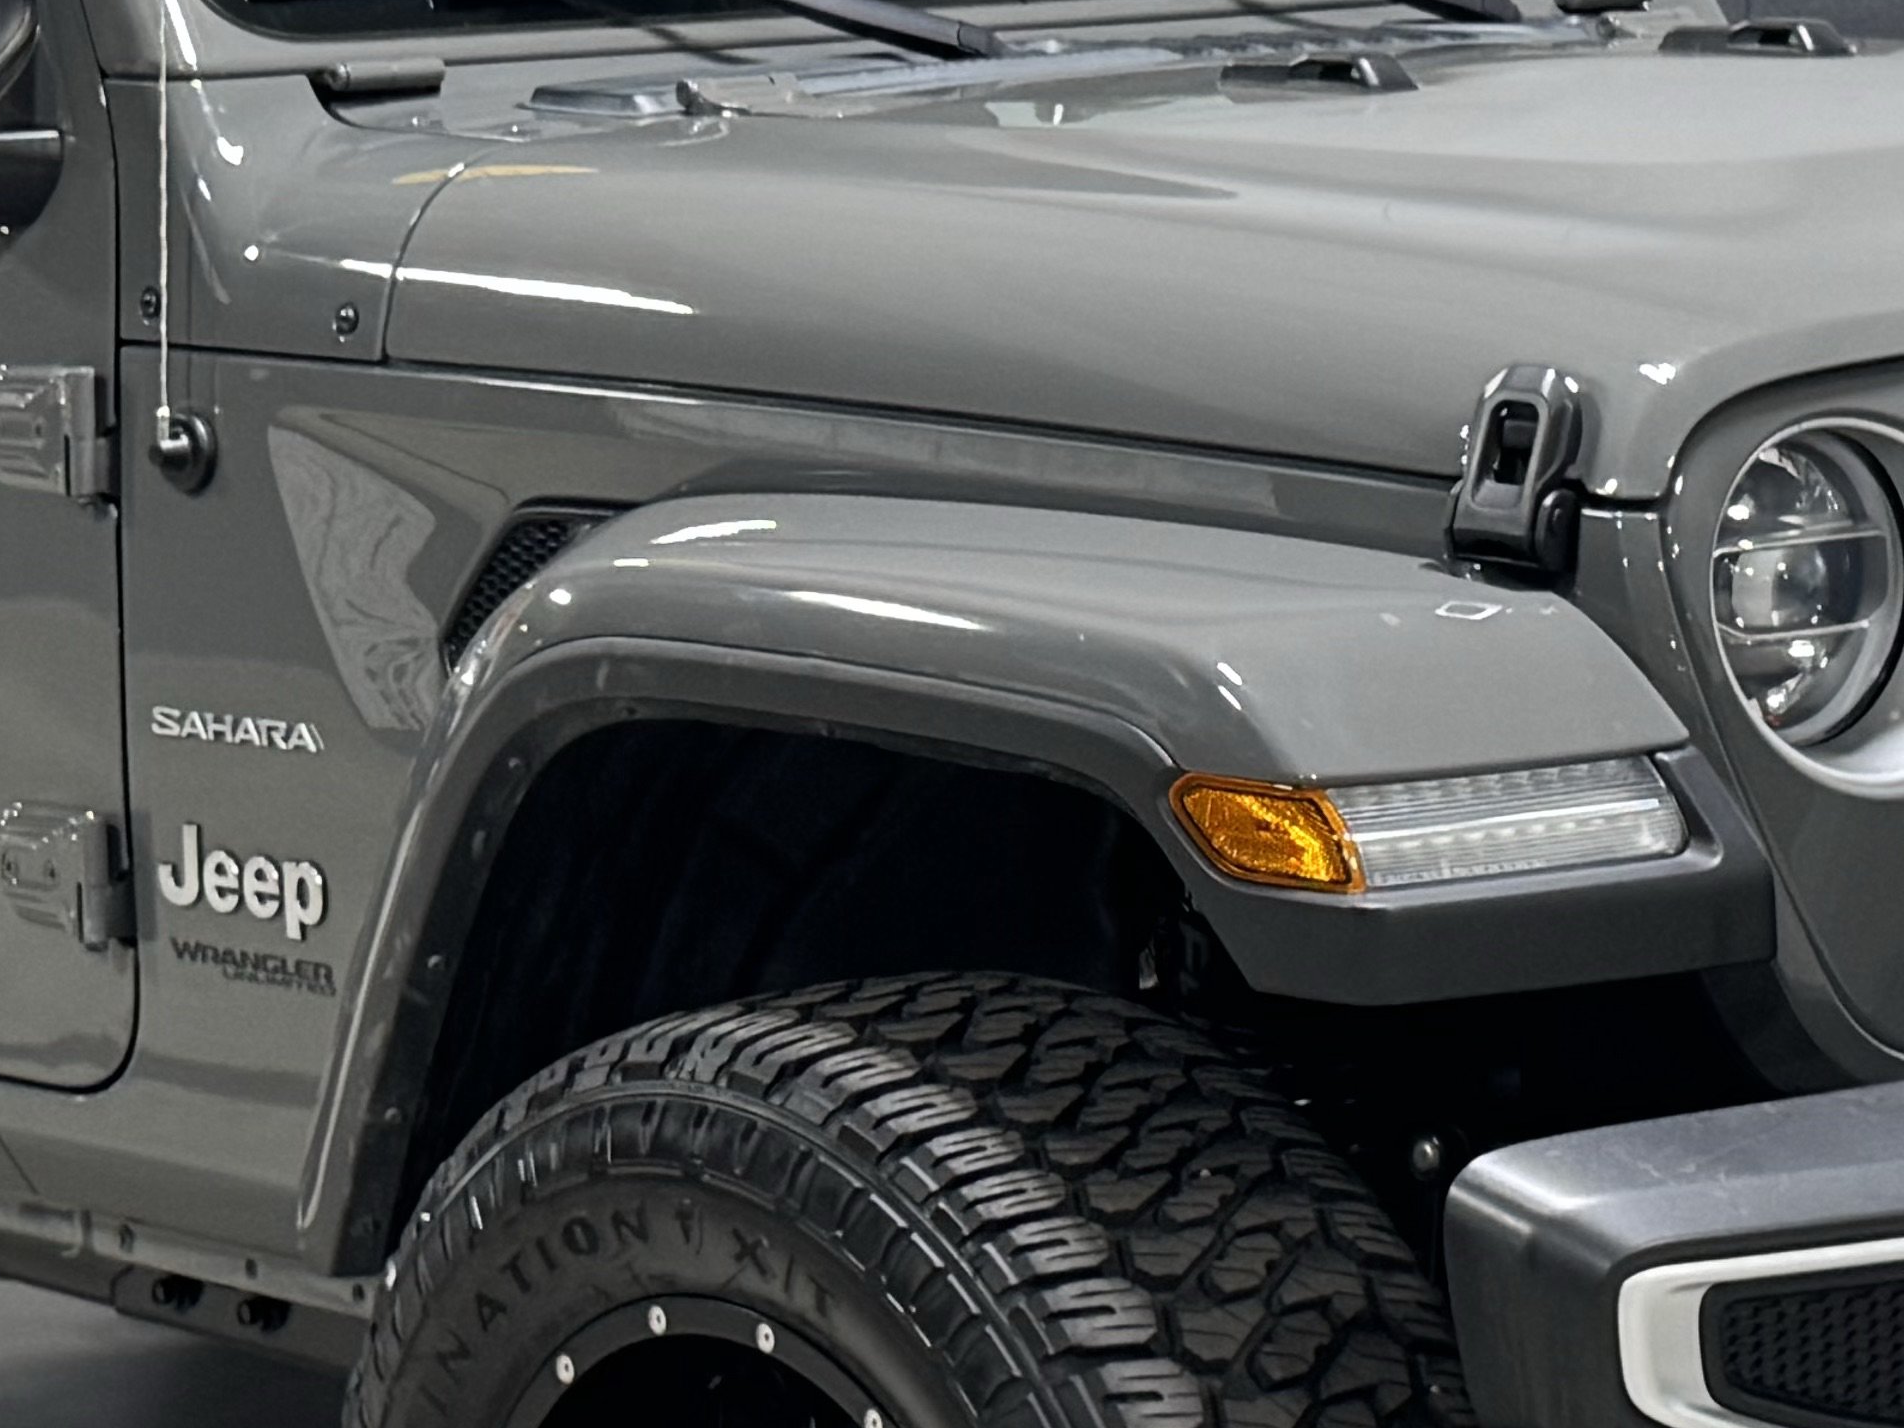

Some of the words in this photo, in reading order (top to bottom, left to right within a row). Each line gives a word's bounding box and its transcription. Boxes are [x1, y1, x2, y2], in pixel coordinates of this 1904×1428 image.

[151, 705, 320, 753] SAHARA
[158, 823, 326, 941] Jeep
[170, 936, 335, 983] WRANGLER
